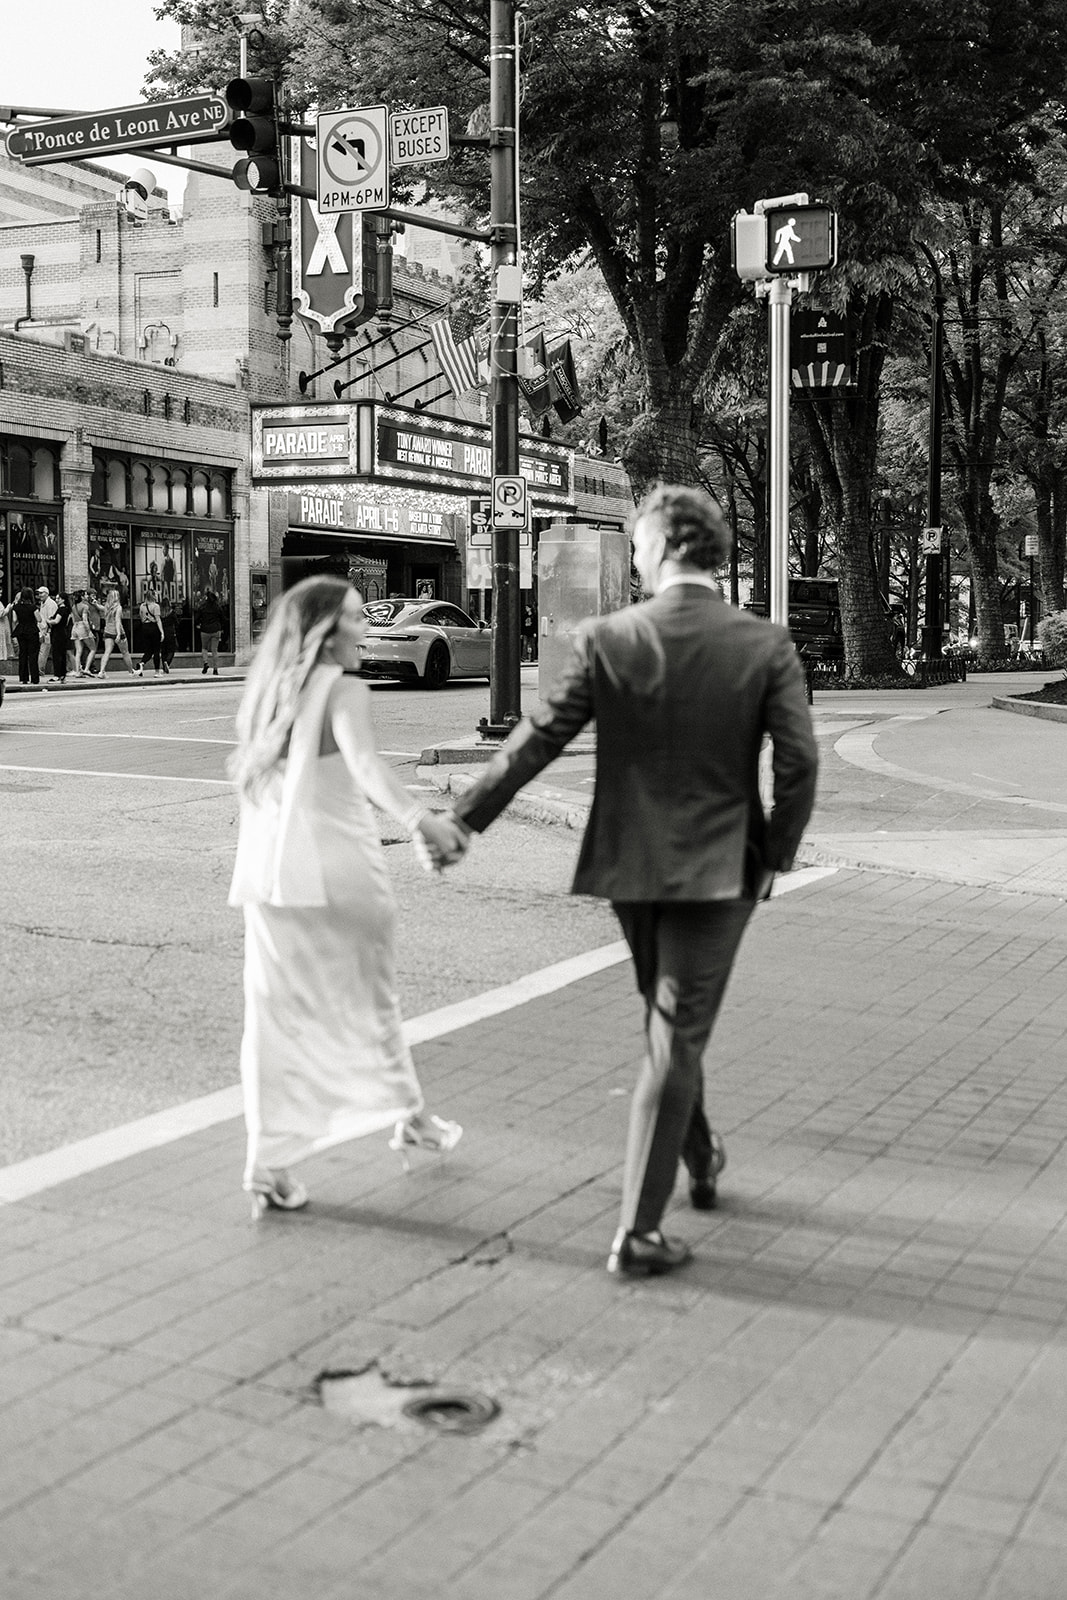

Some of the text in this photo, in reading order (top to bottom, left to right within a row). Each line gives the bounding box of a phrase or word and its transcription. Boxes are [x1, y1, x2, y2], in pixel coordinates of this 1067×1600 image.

[34, 104, 224, 150] Ponce de Leon Ave NE
[394, 113, 443, 137] EXCEPT
[399, 136, 441, 158] BUSES
[265, 431, 327, 455] PARADE
[396, 432, 453, 458] TONY AWARD WINNER
[464, 444, 492, 478] PARA
[300, 496, 399, 532] PARADE APRIL 1-6
[13, 560, 57, 576] PRIVATE
[13, 574, 56, 591] EVENTS
